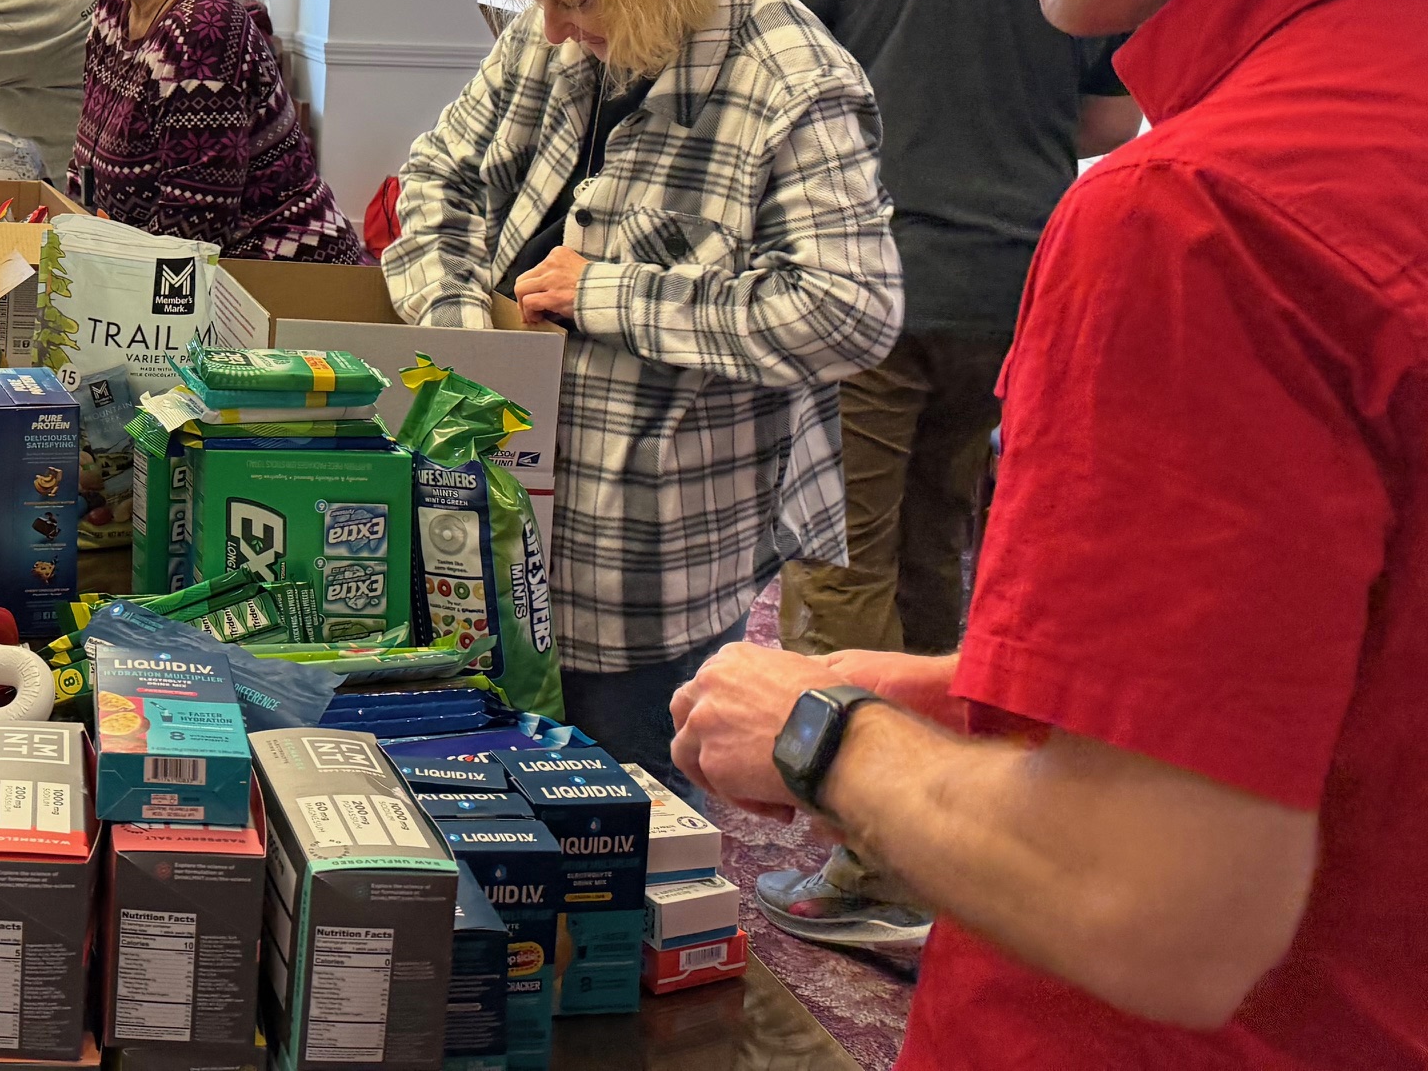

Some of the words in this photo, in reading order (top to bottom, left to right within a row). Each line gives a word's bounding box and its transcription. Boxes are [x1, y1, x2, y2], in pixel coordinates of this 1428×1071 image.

[155, 296, 193, 304] Member's
[88, 317, 179, 351] TRAIL
[61, 369, 76, 386] 15
[24, 434, 77, 442] DELICIOUSLY
[432, 489, 459, 498] MINTS
[327, 517, 386, 544] Extra
[227, 540, 238, 569] LONG
[326, 574, 384, 601] Extra
[510, 563, 528, 619] MINTS
[524, 519, 552, 653] LIFESAVERS
[114, 659, 188, 672] LIQUID
[190, 663, 214, 675] I.V.
[103, 670, 161, 679] HYDRATION
[162, 671, 223, 683] MULTIPLIER
[180, 716, 233, 724] HYDRATION
[170, 731, 186, 740] 8
[519, 760, 585, 772] LIQUID
[586, 759, 607, 769] I.V.
[415, 768, 467, 780] LIQUID
[468, 771, 487, 781] I.V.
[15, 786, 26, 800] 200
[53, 789, 64, 807] 1000
[541, 786, 608, 799] LIQUID
[609, 785, 632, 797] I.V.
[462, 833, 516, 842] LIQUID
[518, 833, 538, 842] I.V.
[121, 911, 165, 922] Nutrition
[169, 914, 196, 923] Facts
[316, 929, 362, 938] Nutrition
[364, 930, 393, 939] Facts
[121, 939, 149, 948] Calories
[184, 942, 194, 950] 10
[15, 949, 20, 957] 5
[315, 957, 345, 965] Calories
